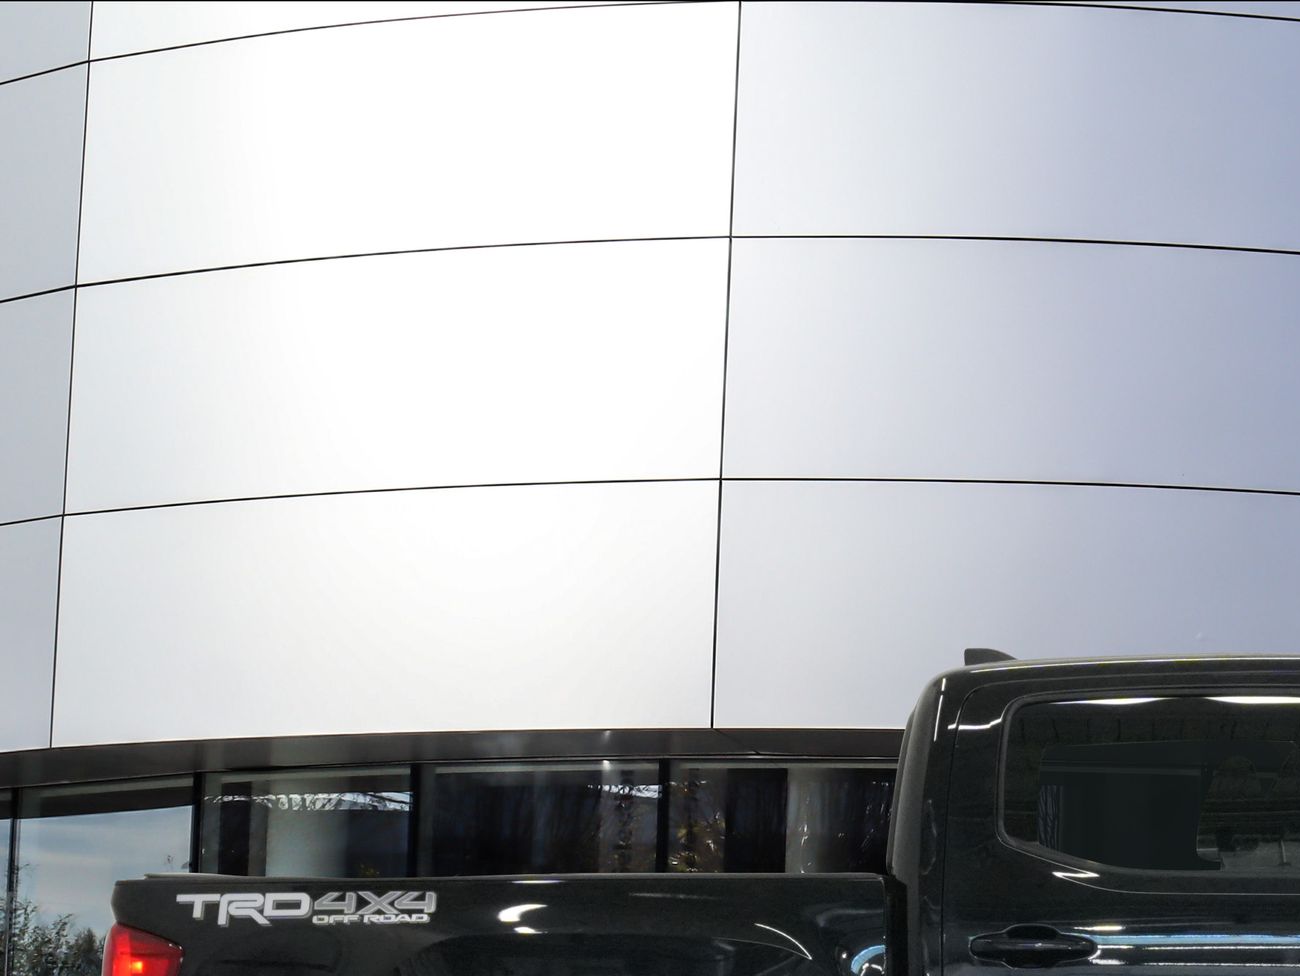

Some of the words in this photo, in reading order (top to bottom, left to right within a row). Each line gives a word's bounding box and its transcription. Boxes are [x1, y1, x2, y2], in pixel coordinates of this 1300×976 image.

[176, 891, 312, 927] TRD
[312, 914, 360, 925] OFF
[363, 914, 430, 924] ROAD
